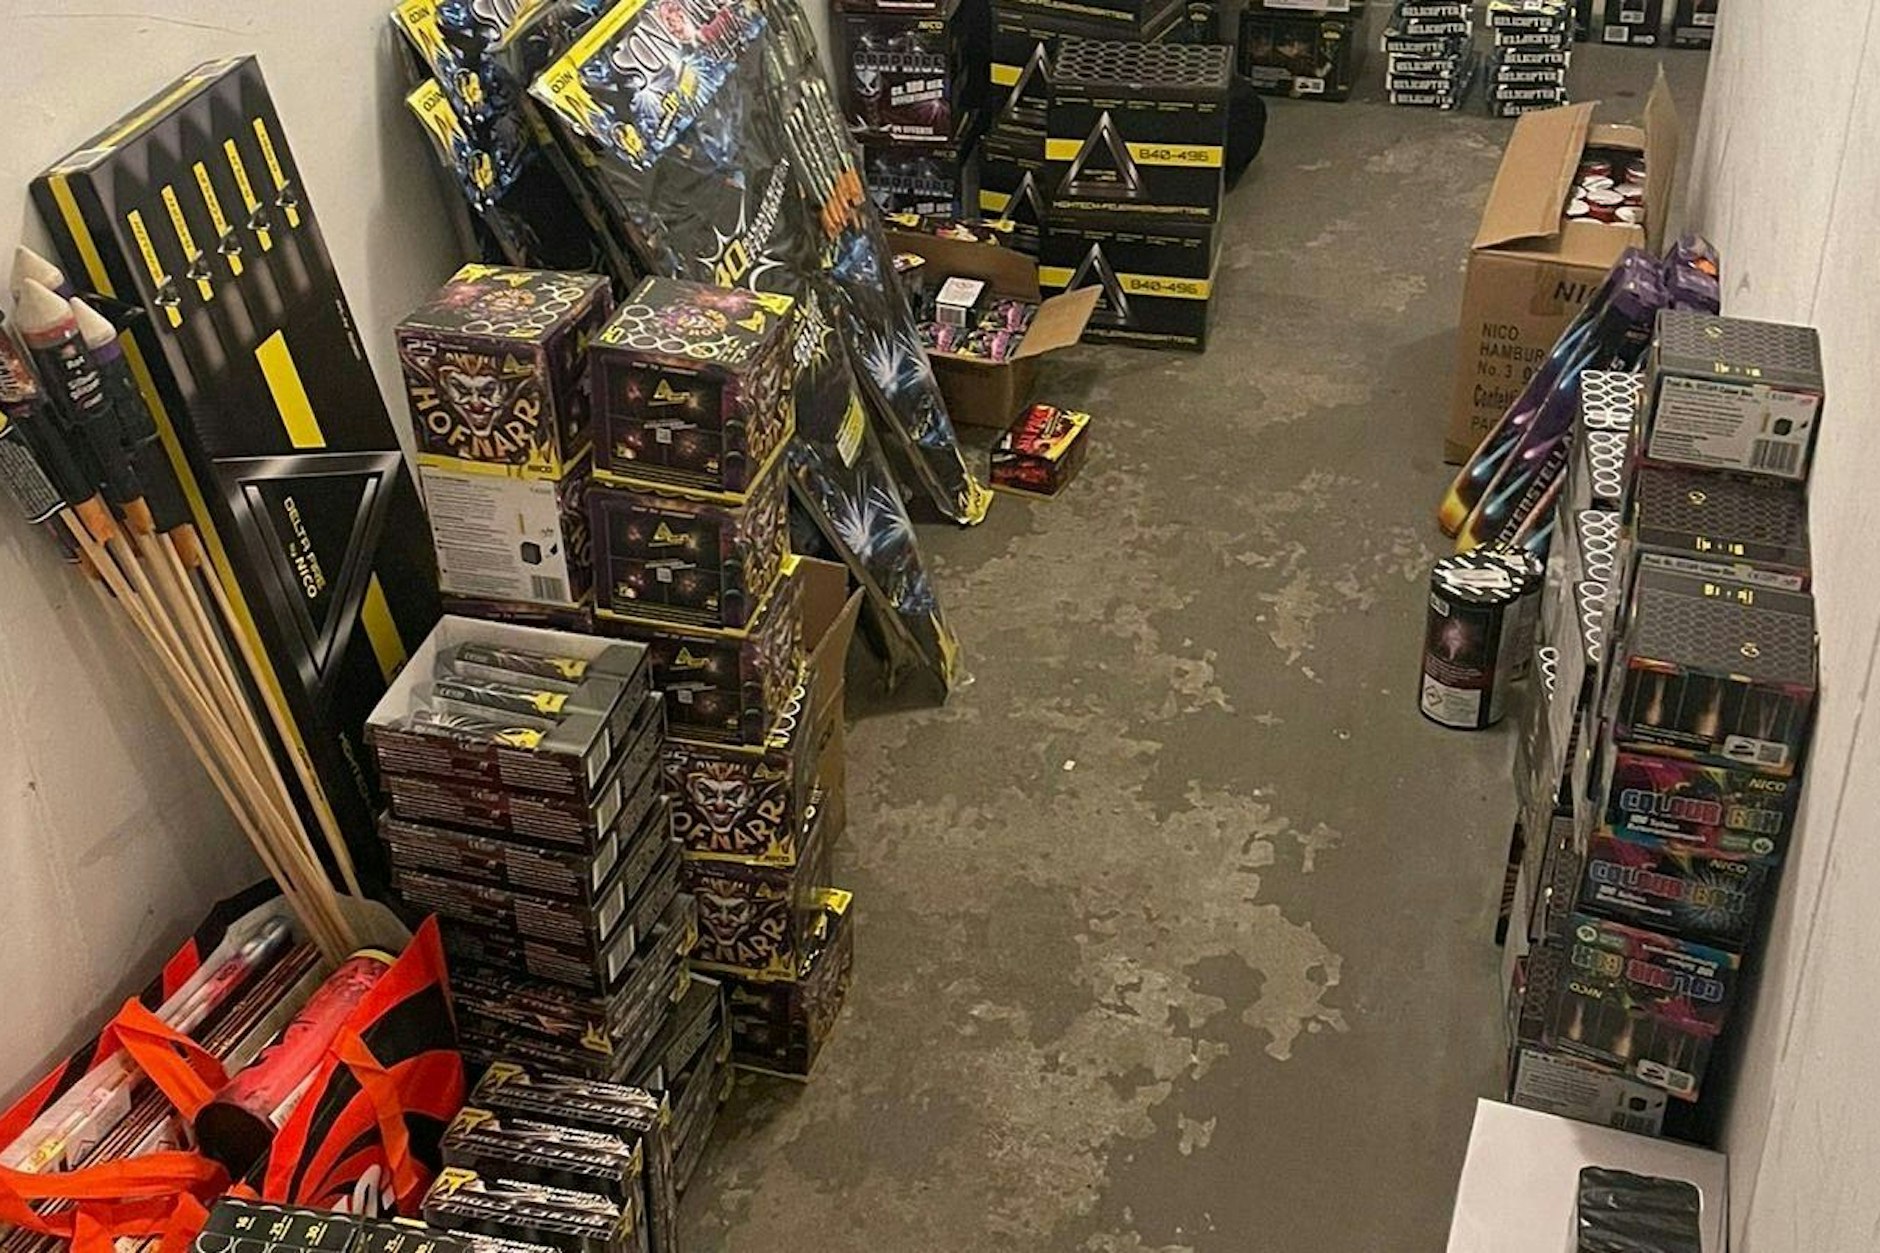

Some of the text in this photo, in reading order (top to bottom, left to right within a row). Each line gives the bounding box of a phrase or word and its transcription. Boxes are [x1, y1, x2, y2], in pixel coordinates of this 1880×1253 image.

[1553, 280, 1596, 304] NI
[1481, 322, 1520, 342] NICO
[406, 338, 437, 356] 25
[411, 387, 541, 460] HOFNARR
[284, 496, 311, 557] DELTA
[294, 555, 318, 599] NICO
[1748, 778, 1788, 794] NICO
[1709, 859, 1749, 875] NICO
[1569, 981, 1603, 998] NICO
